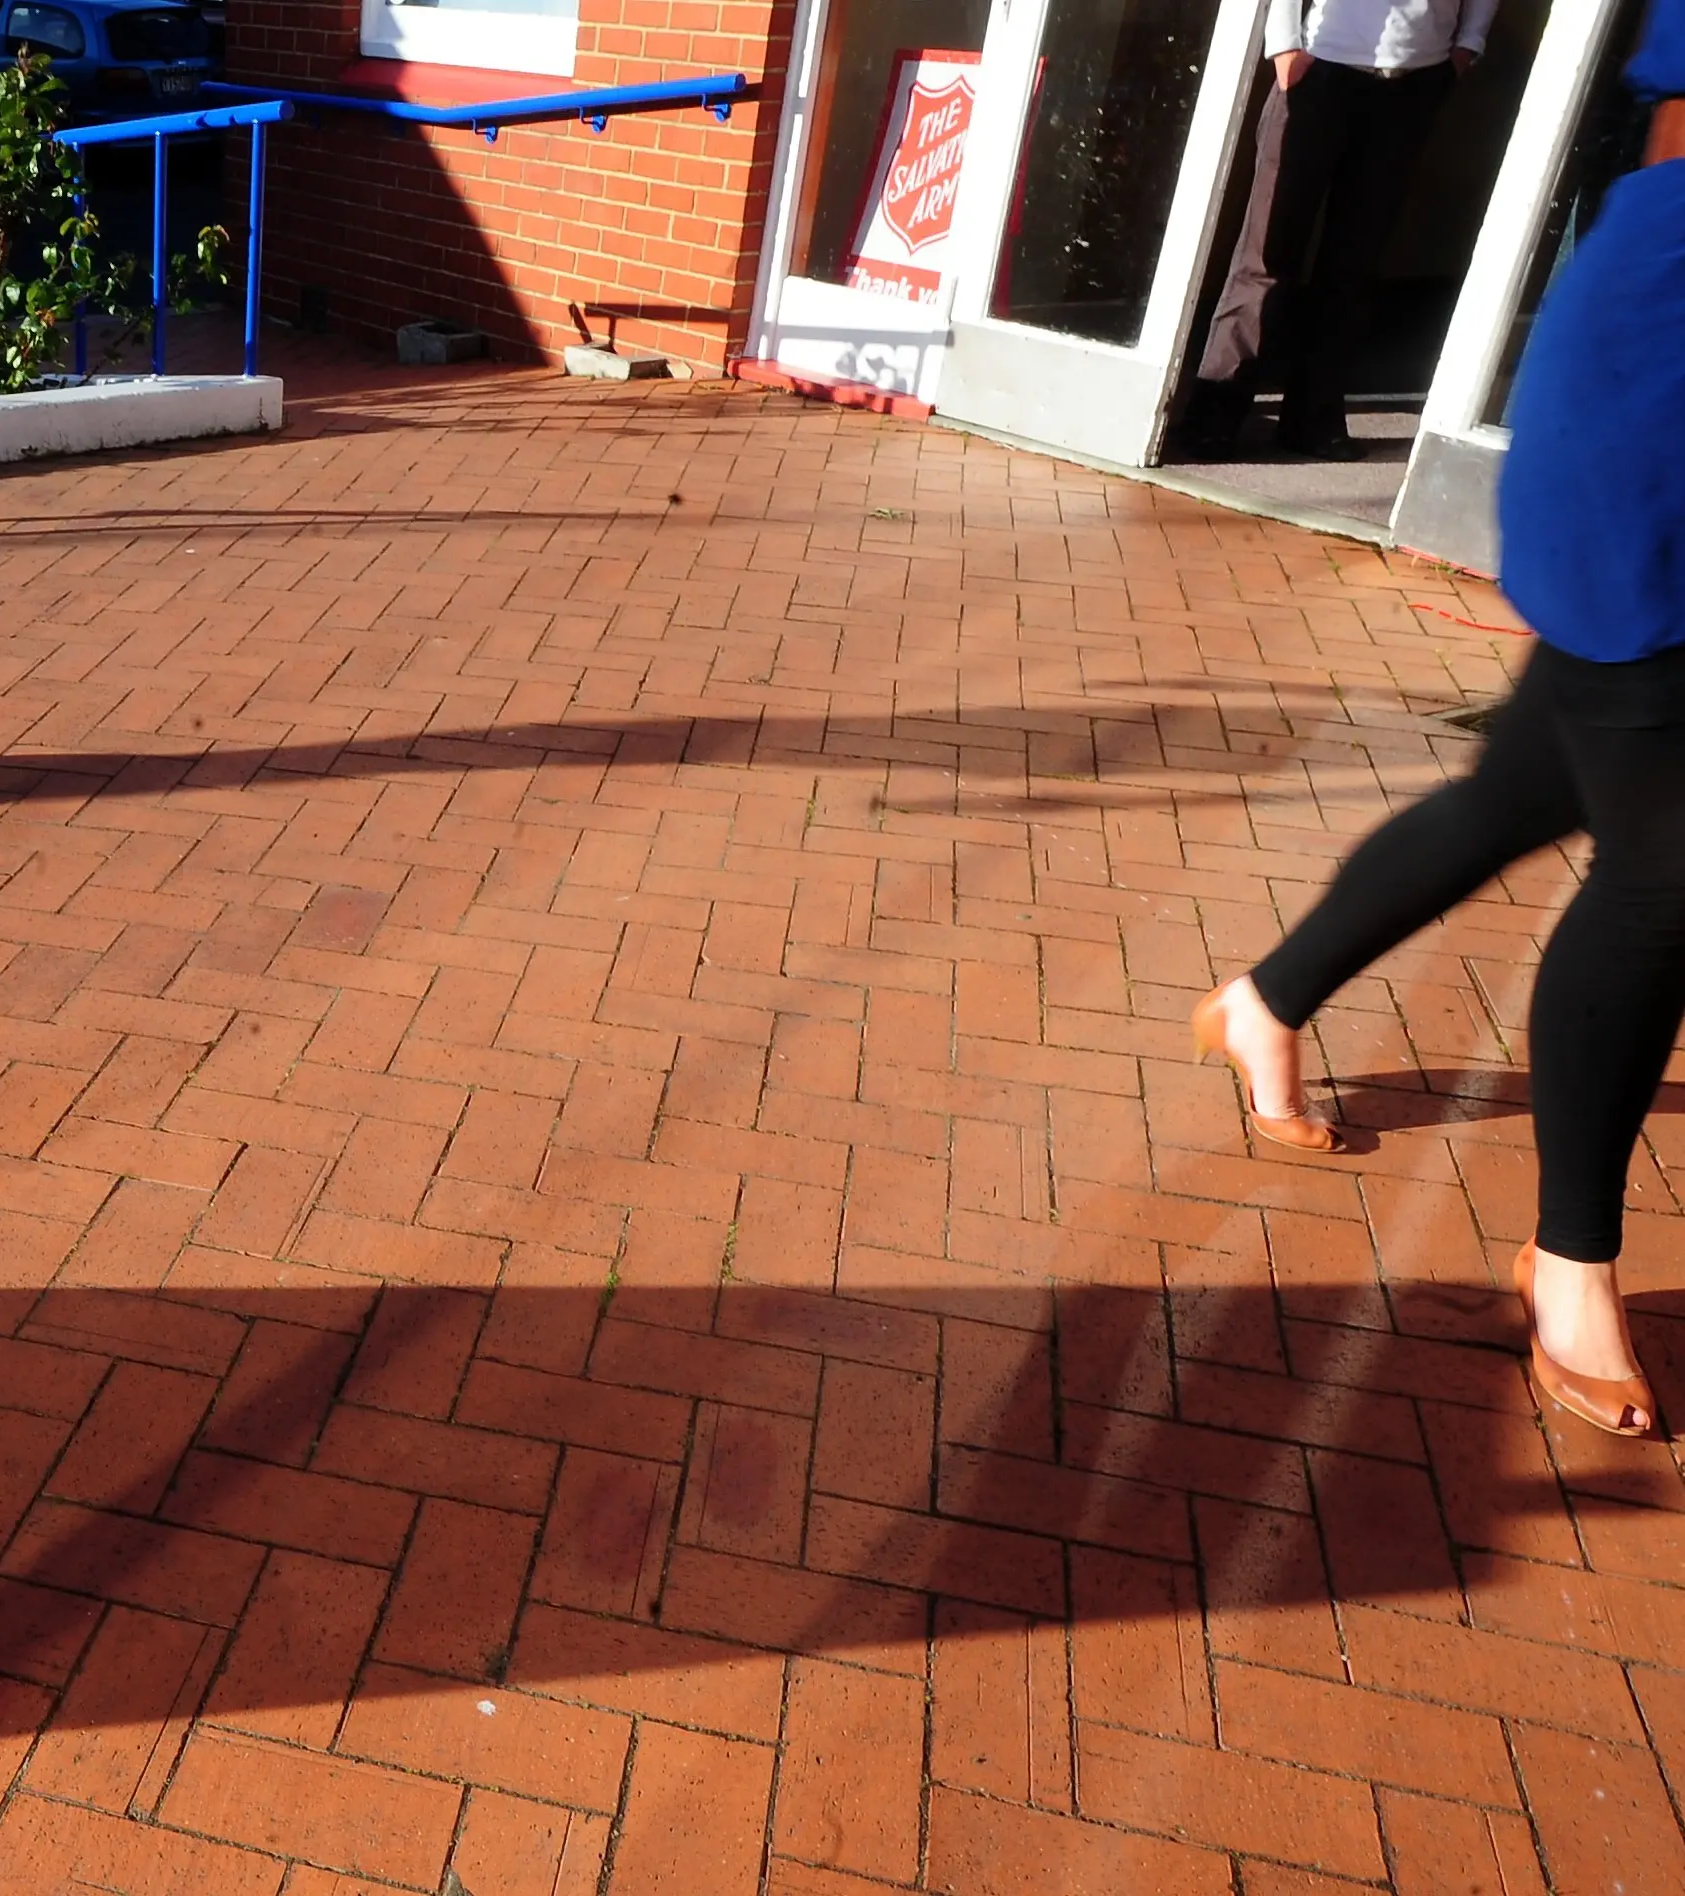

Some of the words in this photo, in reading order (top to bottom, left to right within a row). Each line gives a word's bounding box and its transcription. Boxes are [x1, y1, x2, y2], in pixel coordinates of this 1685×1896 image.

[917, 97, 962, 149] THE
[886, 129, 968, 202] SALVATI
[907, 171, 960, 229] ARM
[844, 265, 913, 299] Thank
